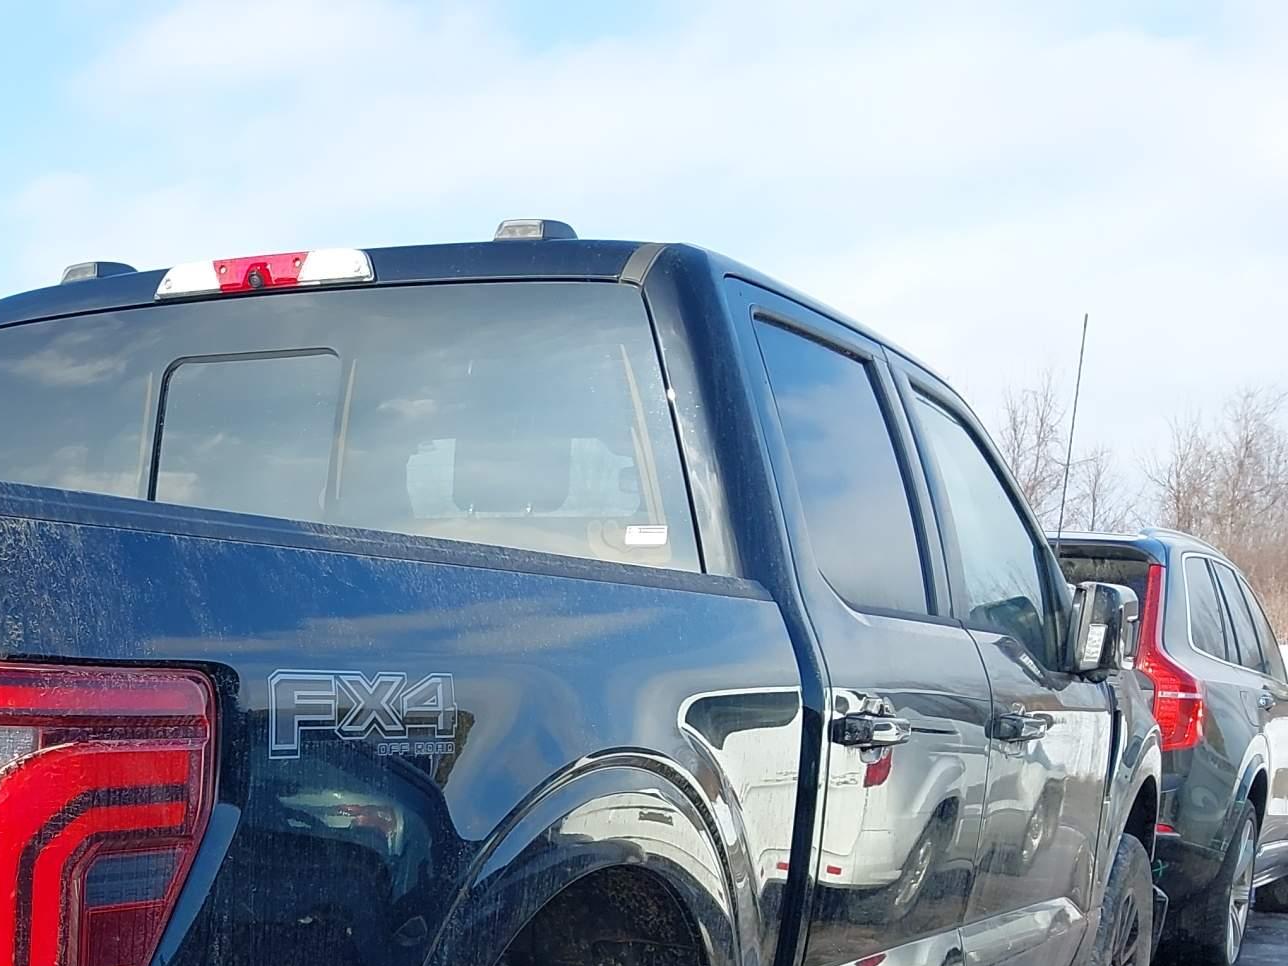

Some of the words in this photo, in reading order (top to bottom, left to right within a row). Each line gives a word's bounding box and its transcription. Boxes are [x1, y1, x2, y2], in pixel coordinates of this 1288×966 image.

[268, 668, 458, 760] FX4
[377, 742, 410, 756] OFF
[414, 741, 455, 755] ROAD
